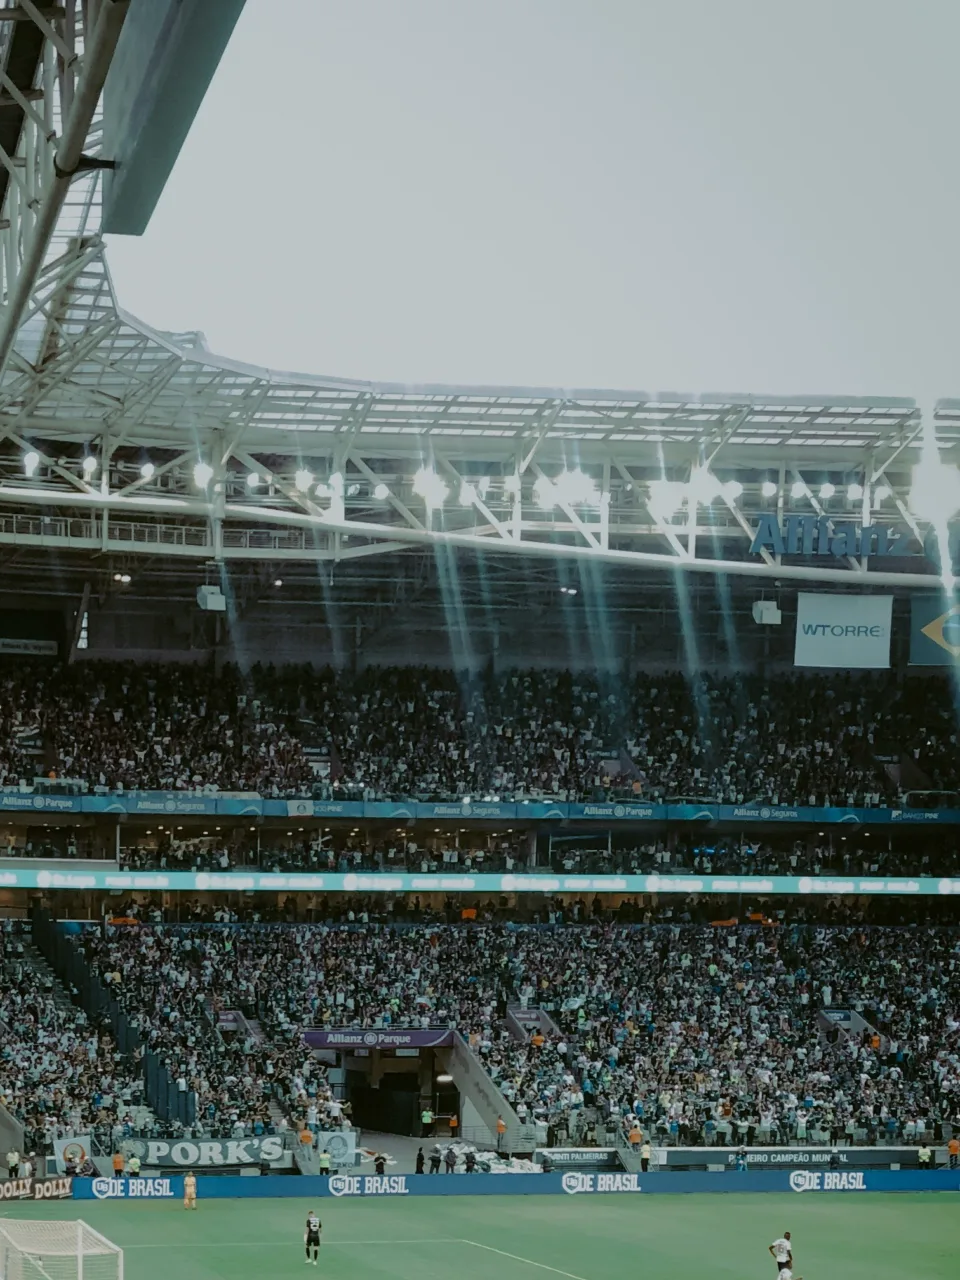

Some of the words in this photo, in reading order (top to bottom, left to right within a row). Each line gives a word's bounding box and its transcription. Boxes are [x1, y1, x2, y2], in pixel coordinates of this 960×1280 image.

[749, 514, 913, 557] Allianz
[802, 623, 881, 638] WTORRE
[2, 796, 32, 806] Allianz
[45, 798, 73, 809] Parque
[137, 800, 165, 810] Allianz
[176, 801, 206, 812] Seguros
[433, 806, 461, 815] Allianz
[473, 806, 501, 816] Seguros
[583, 806, 613, 815] Allianz
[625, 807, 653, 817] Parque
[733, 808, 759, 817] Allianz
[771, 809, 798, 819] Seguros
[326, 1033, 363, 1044] Allianz
[378, 1034, 411, 1046] Parque
[146, 1136, 283, 1166] PORK'S
[570, 1152, 609, 1161] PALMEIRAS
[770, 1152, 810, 1163] CAMPEÃO
[811, 1153, 849, 1163] MUNAL
[109, 1179, 125, 1197] DE
[128, 1178, 174, 1197] BRASIL
[346, 1176, 361, 1194] DE
[364, 1176, 409, 1194] BRASIL
[580, 1174, 595, 1191] DE
[597, 1174, 641, 1191] BRASIL
[808, 1172, 822, 1189] DE
[824, 1172, 867, 1190] BRASIL
[34, 1178, 73, 1199] DOLLY
